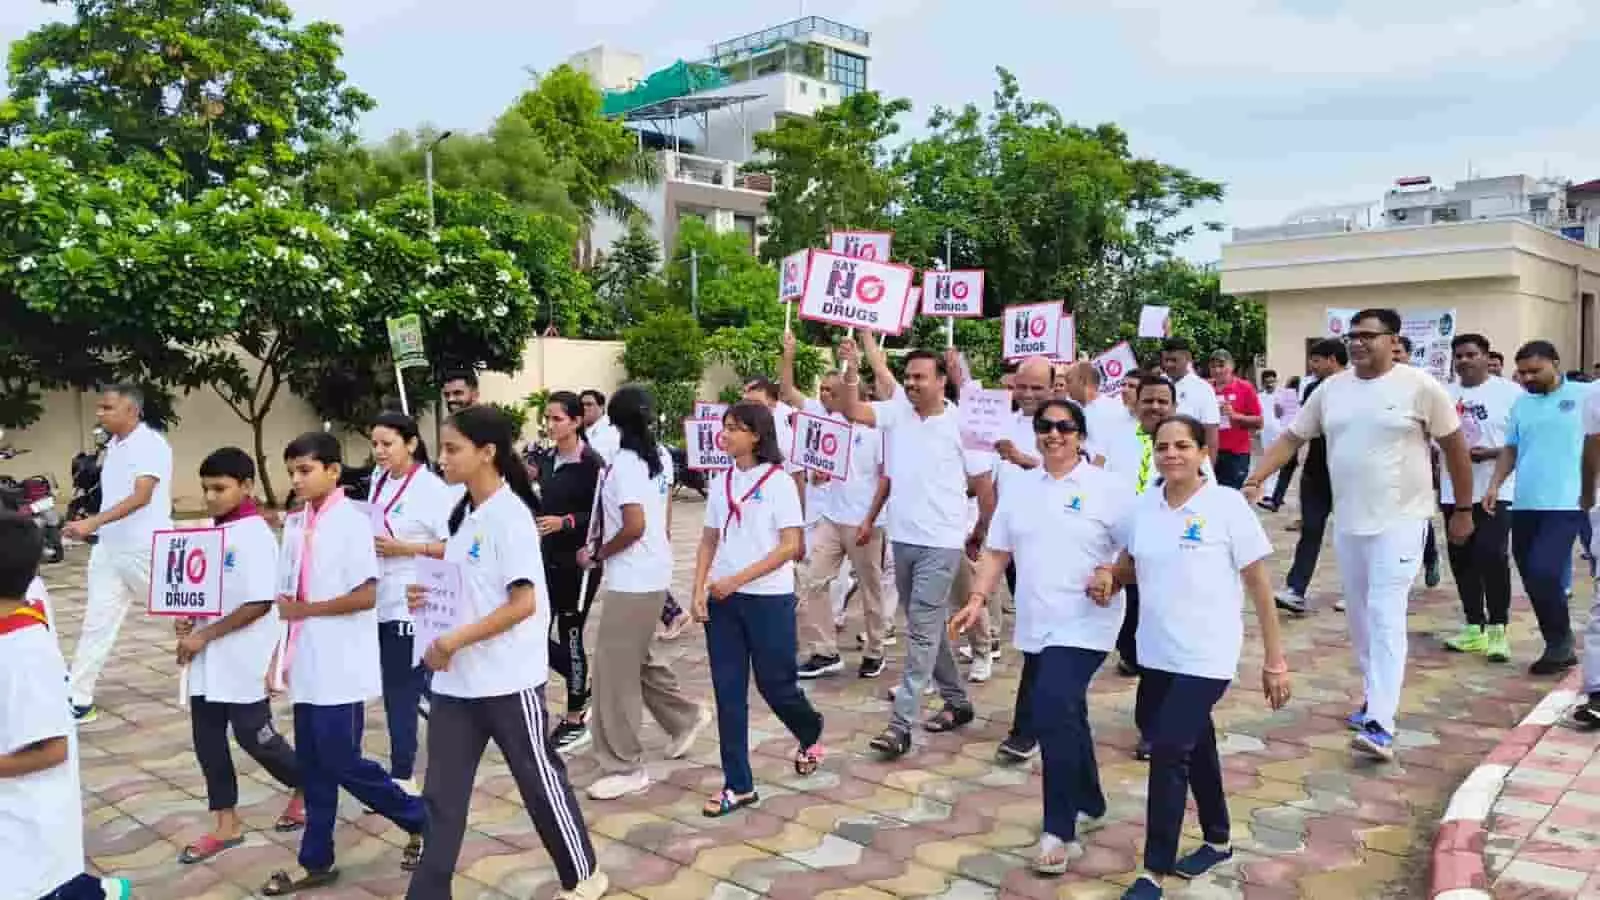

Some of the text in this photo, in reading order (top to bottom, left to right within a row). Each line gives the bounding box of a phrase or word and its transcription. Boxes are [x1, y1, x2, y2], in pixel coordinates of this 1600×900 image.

[832, 260, 857, 271] SAY
[826, 270, 885, 304] NO
[936, 280, 969, 299] NO
[822, 302, 879, 322] DRUGS
[935, 303, 968, 312] DRUGS
[1015, 315, 1047, 338] NO
[1014, 341, 1046, 353] DRUGS
[805, 428, 837, 456] NO
[803, 453, 835, 470] DRUGS
[170, 538, 187, 549] SAY
[167, 547, 207, 584] NO
[166, 592, 205, 607] DRUGS
